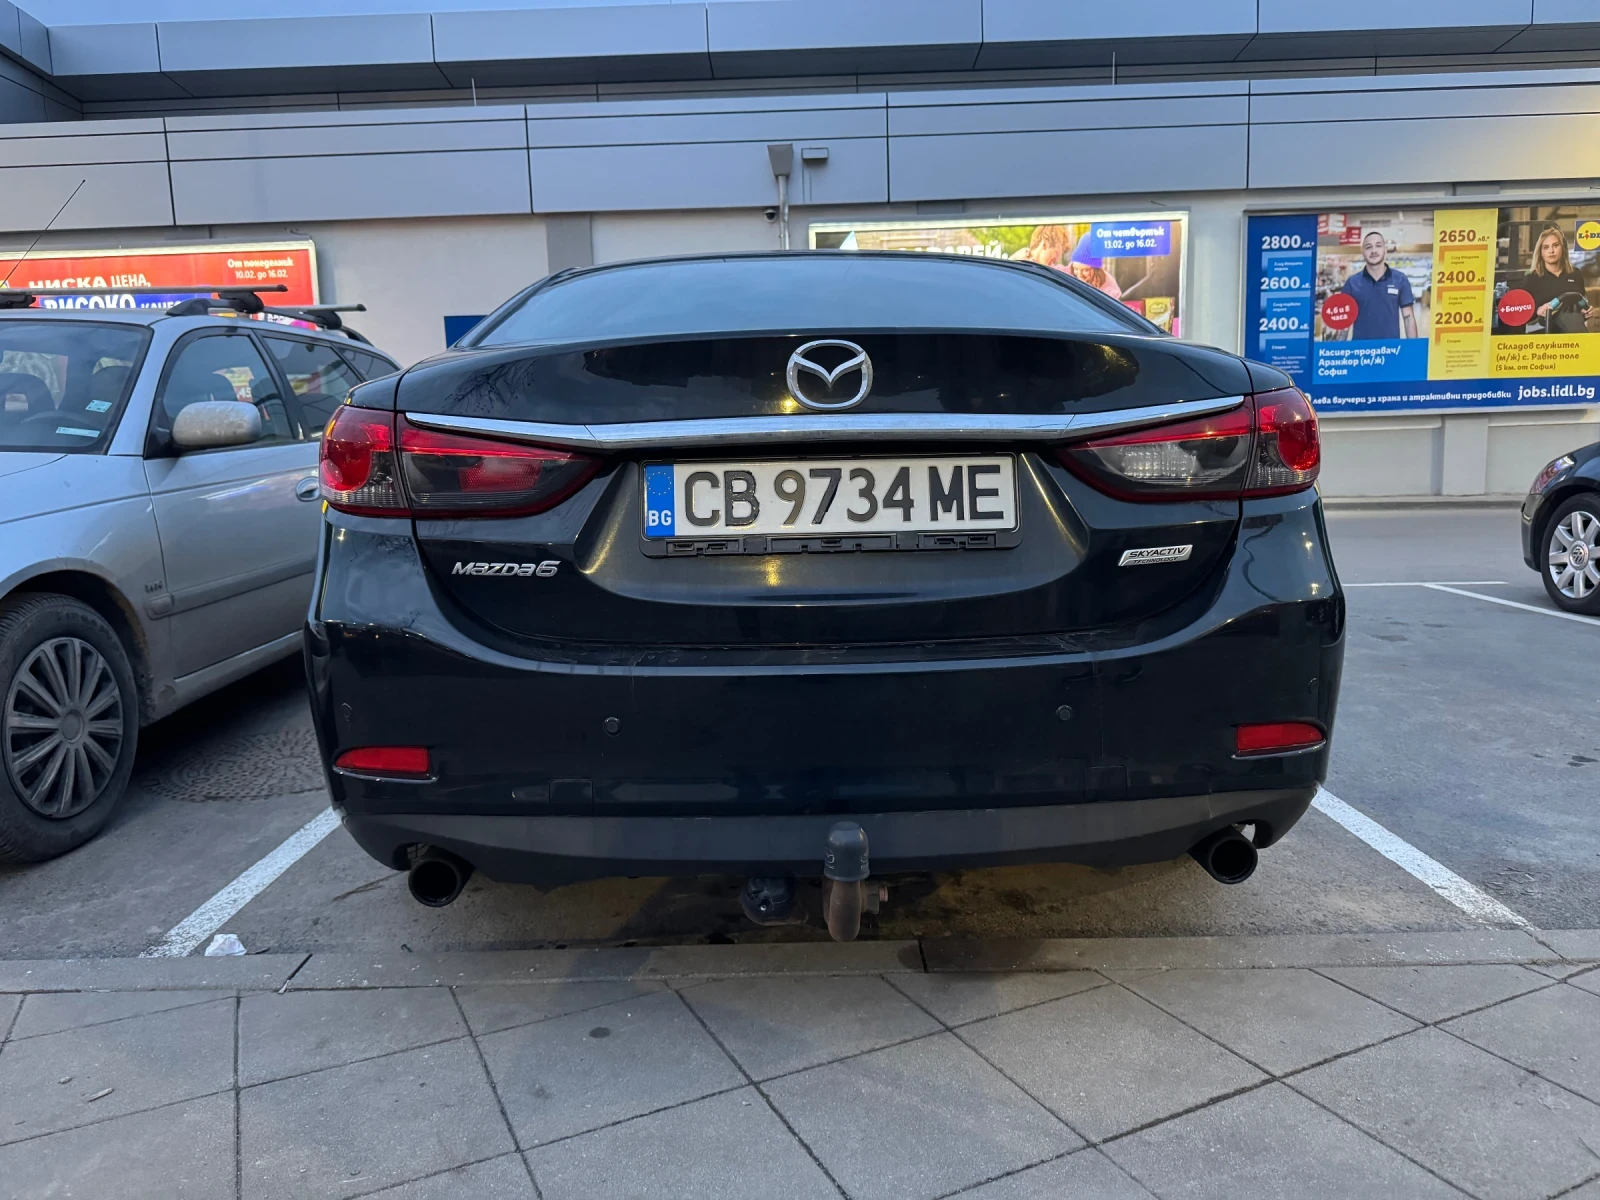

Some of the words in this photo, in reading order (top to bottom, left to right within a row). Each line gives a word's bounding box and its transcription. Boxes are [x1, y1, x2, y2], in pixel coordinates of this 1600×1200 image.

[1096, 228, 1111, 238] От
[1113, 226, 1165, 238] четвъртък
[1438, 229, 1476, 243] 2650
[1103, 240, 1125, 249] 13.02.
[1125, 241, 1135, 250] до
[1136, 239, 1157, 248] 16.02.
[1261, 235, 1301, 249] 2800
[227, 258, 242, 268] От
[235, 270, 256, 279] 10.02.
[268, 269, 288, 278] 16.02.
[1437, 270, 1476, 284] 2400
[1260, 276, 1301, 290] 2600
[1259, 317, 1299, 331] 2400
[1435, 311, 1473, 325] 2200
[1318, 344, 1401, 357] Касиер-продавач/
[1497, 342, 1534, 351] Складов
[1536, 341, 1580, 351] служител
[1318, 358, 1359, 368] Аранжор
[1360, 356, 1385, 366] (м/ж)
[1496, 353, 1521, 363] (м/ж)
[1318, 367, 1348, 377] София
[1529, 363, 1556, 371] София)
[1312, 396, 1331, 404] лева
[1332, 396, 1366, 405] ваучери
[1367, 396, 1376, 404] за
[1377, 396, 1401, 405] храна
[1409, 392, 1460, 402] атрактивни
[1462, 390, 1512, 401] придобивки
[1517, 384, 1596, 401] jobs.lidl.bg
[684, 470, 761, 528] CB
[773, 466, 915, 526] 9734
[927, 464, 1004, 522] ME
[648, 509, 672, 527] BG
[1129, 547, 1187, 558] SKYACTIV
